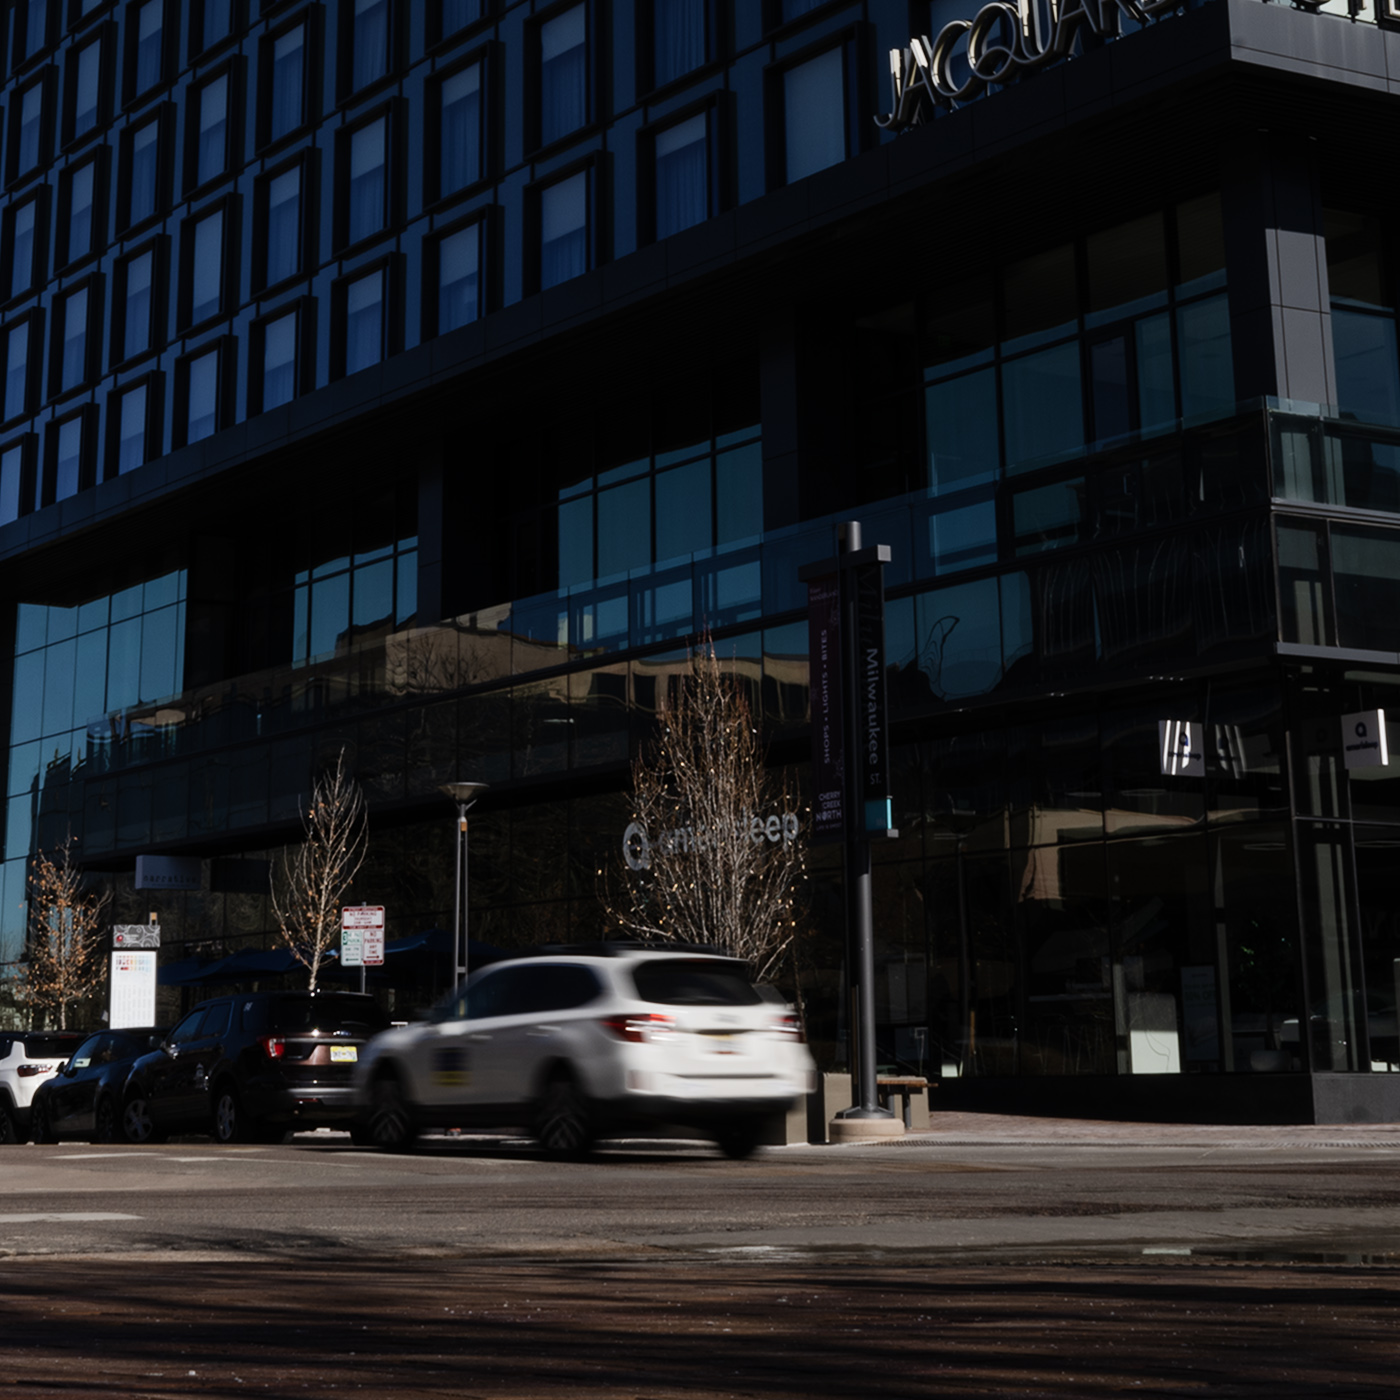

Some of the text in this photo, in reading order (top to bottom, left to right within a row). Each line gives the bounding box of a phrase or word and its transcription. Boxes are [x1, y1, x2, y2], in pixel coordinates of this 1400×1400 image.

[820, 628, 831, 765] SHOPS LIGHTS BITES
[864, 647, 881, 766] Milwaukee
[817, 790, 841, 802] CHERRY
[821, 800, 842, 810] CREEK
[815, 808, 842, 822] NORTH
